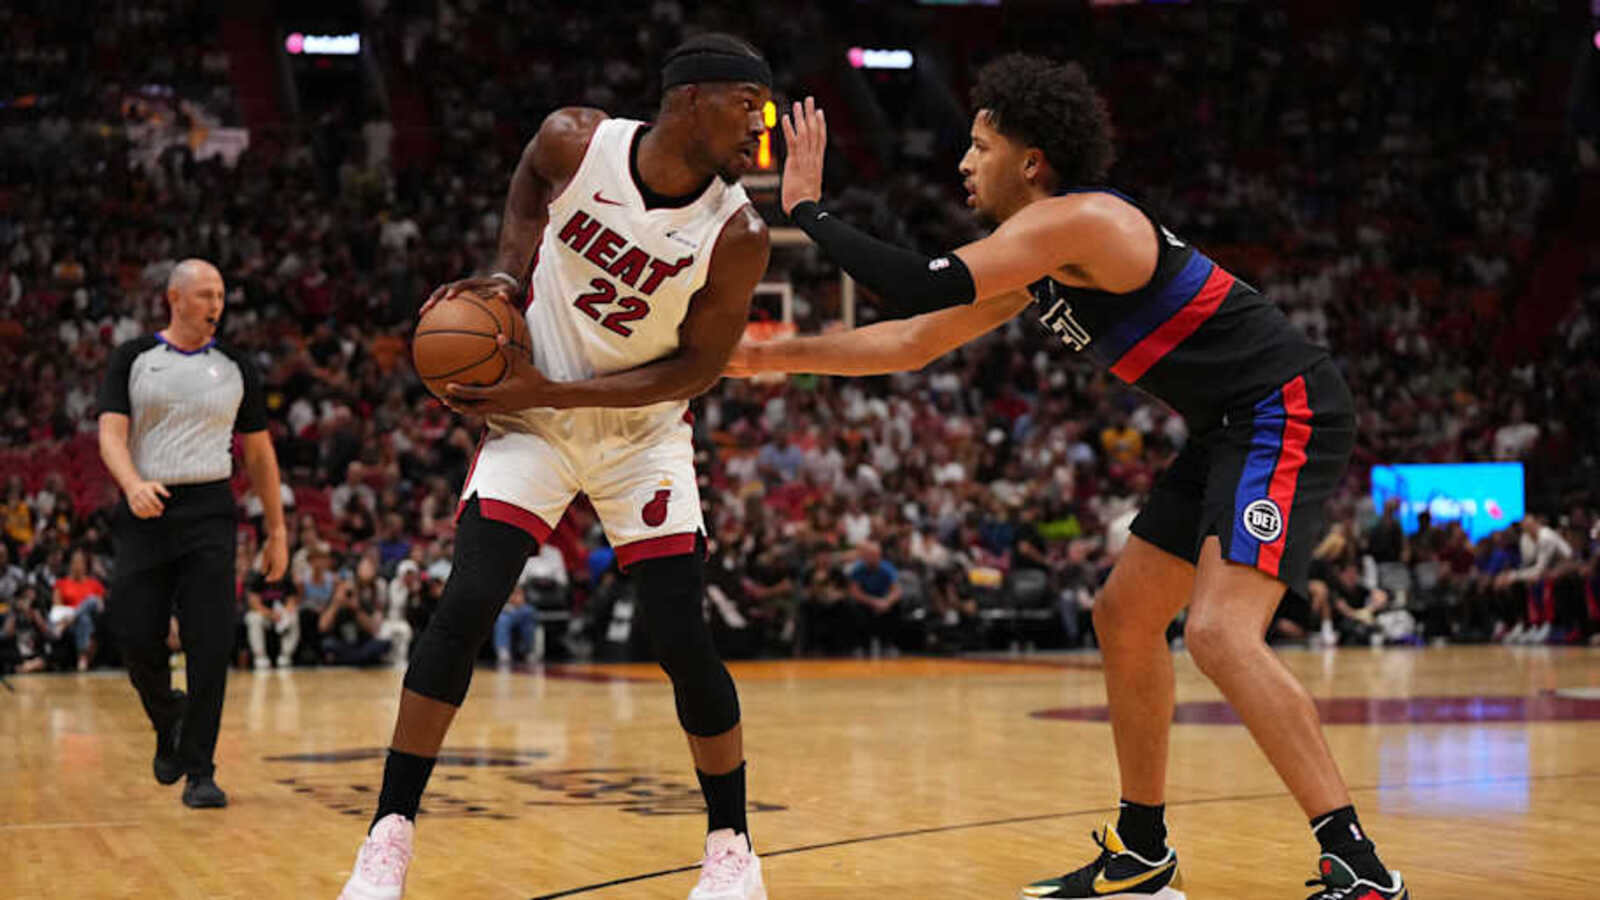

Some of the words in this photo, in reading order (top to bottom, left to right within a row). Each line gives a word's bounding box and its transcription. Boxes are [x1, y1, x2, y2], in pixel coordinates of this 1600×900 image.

[558, 210, 694, 296] HEAT
[573, 278, 650, 338] 22
[1252, 510, 1276, 531] DET
